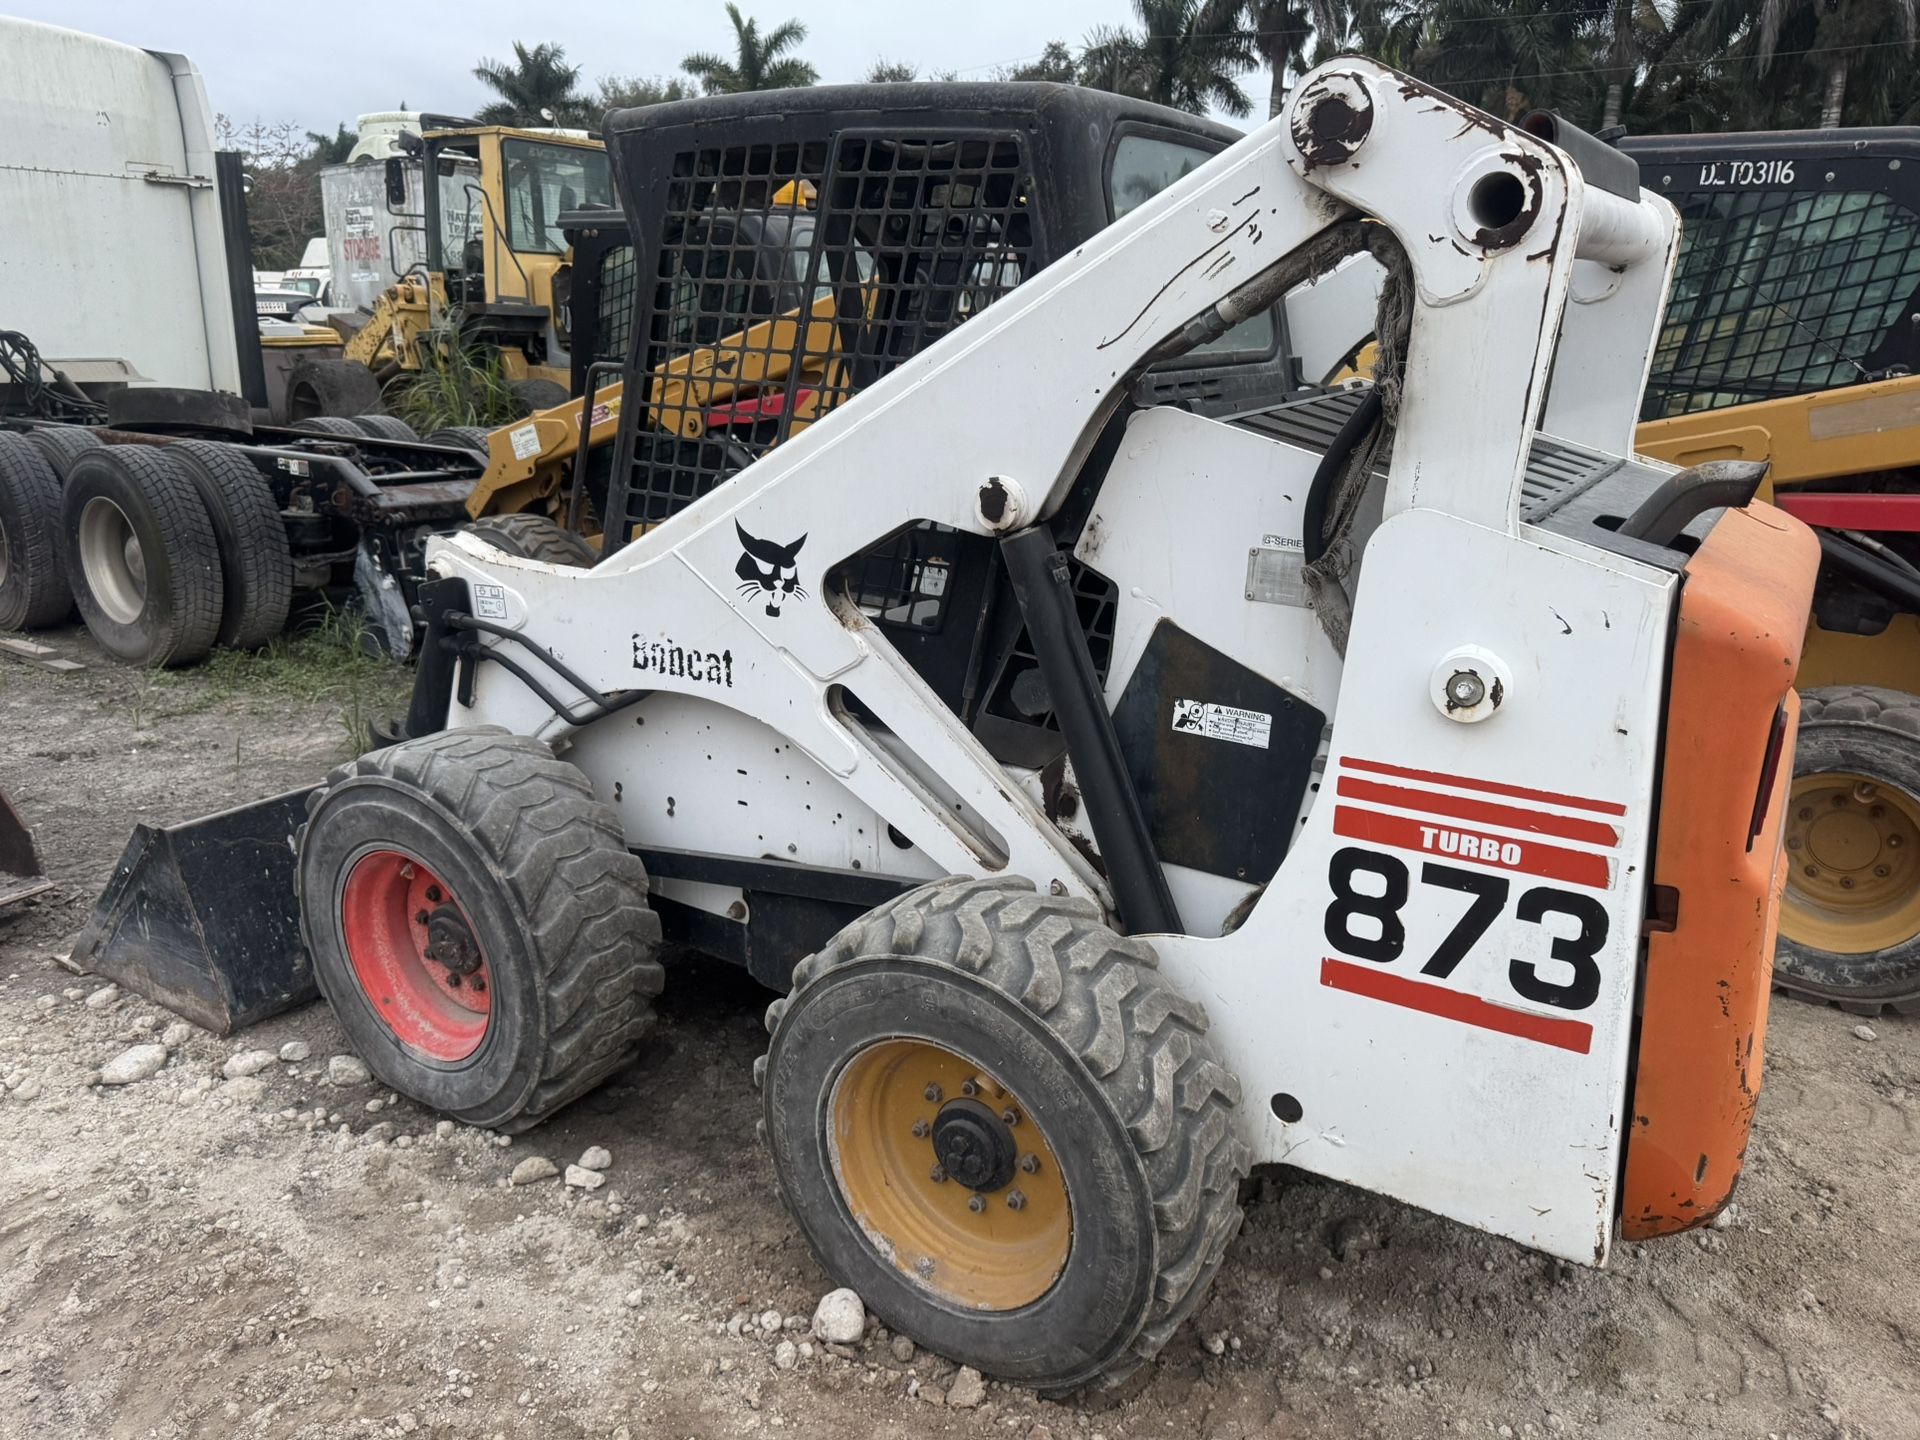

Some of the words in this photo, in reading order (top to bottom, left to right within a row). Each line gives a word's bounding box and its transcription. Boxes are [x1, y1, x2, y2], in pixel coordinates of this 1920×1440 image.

[1264, 536, 1304, 548] G-SERIE
[1225, 708, 1266, 722] WARNING
[1420, 826, 1522, 865] TURBO
[1324, 847, 1610, 1010] 873
